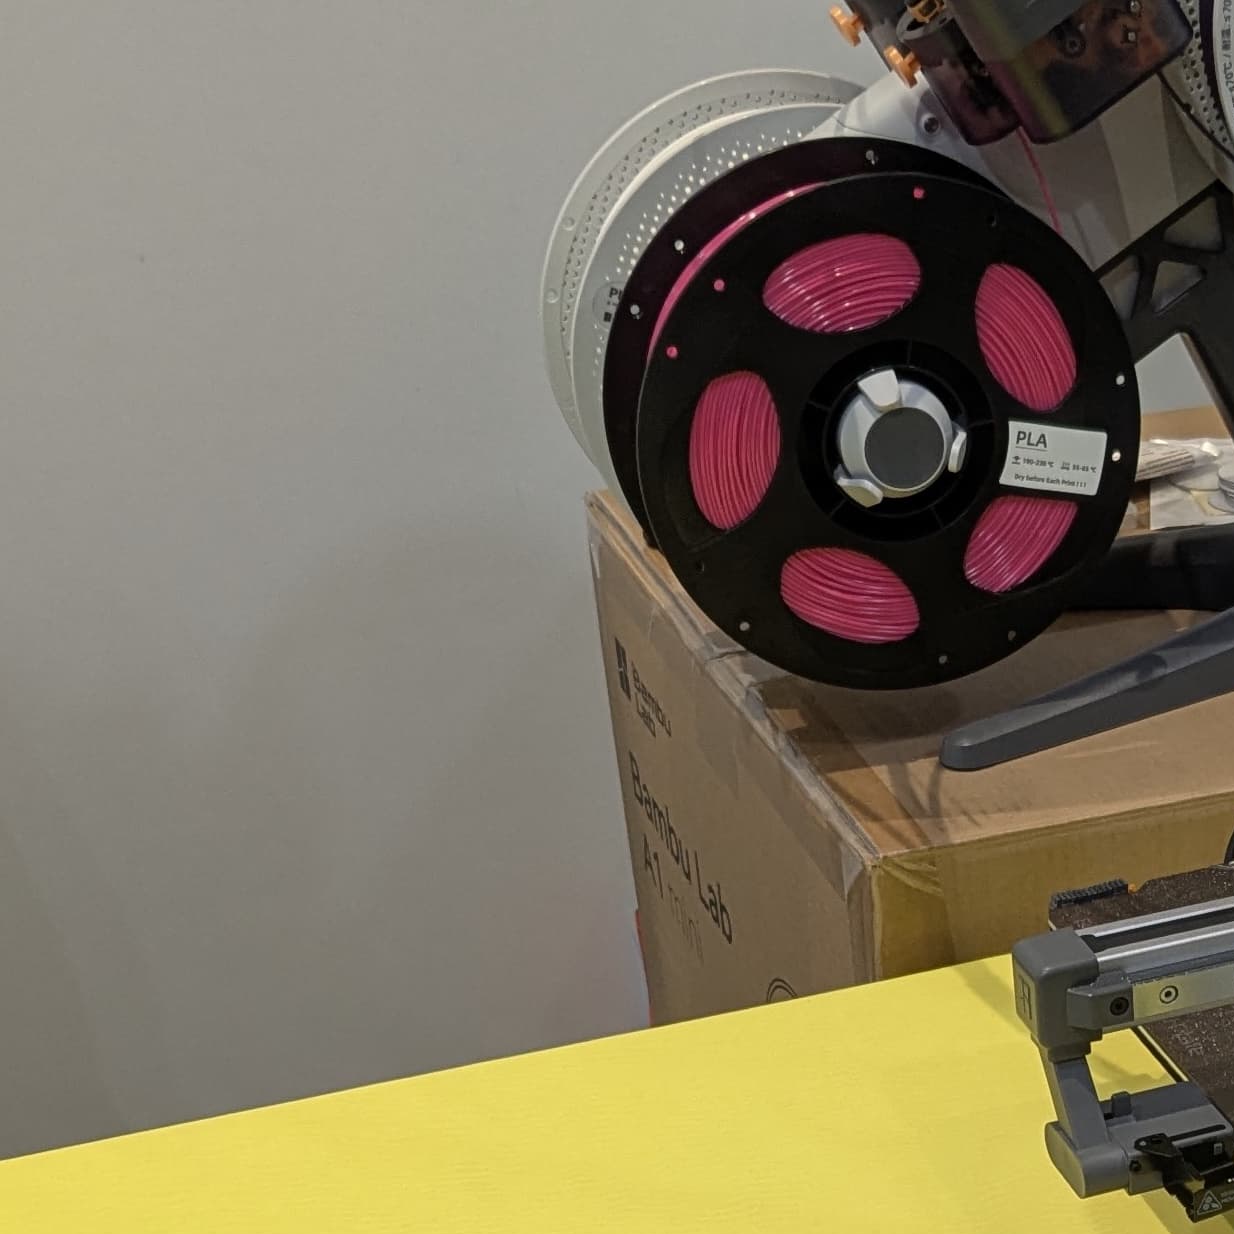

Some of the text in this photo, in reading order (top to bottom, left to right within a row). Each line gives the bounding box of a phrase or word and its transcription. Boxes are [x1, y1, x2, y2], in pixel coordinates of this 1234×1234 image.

[1016, 430, 1047, 448] PLA
[629, 750, 733, 944] Bambu Lab
[643, 832, 664, 899] A1
